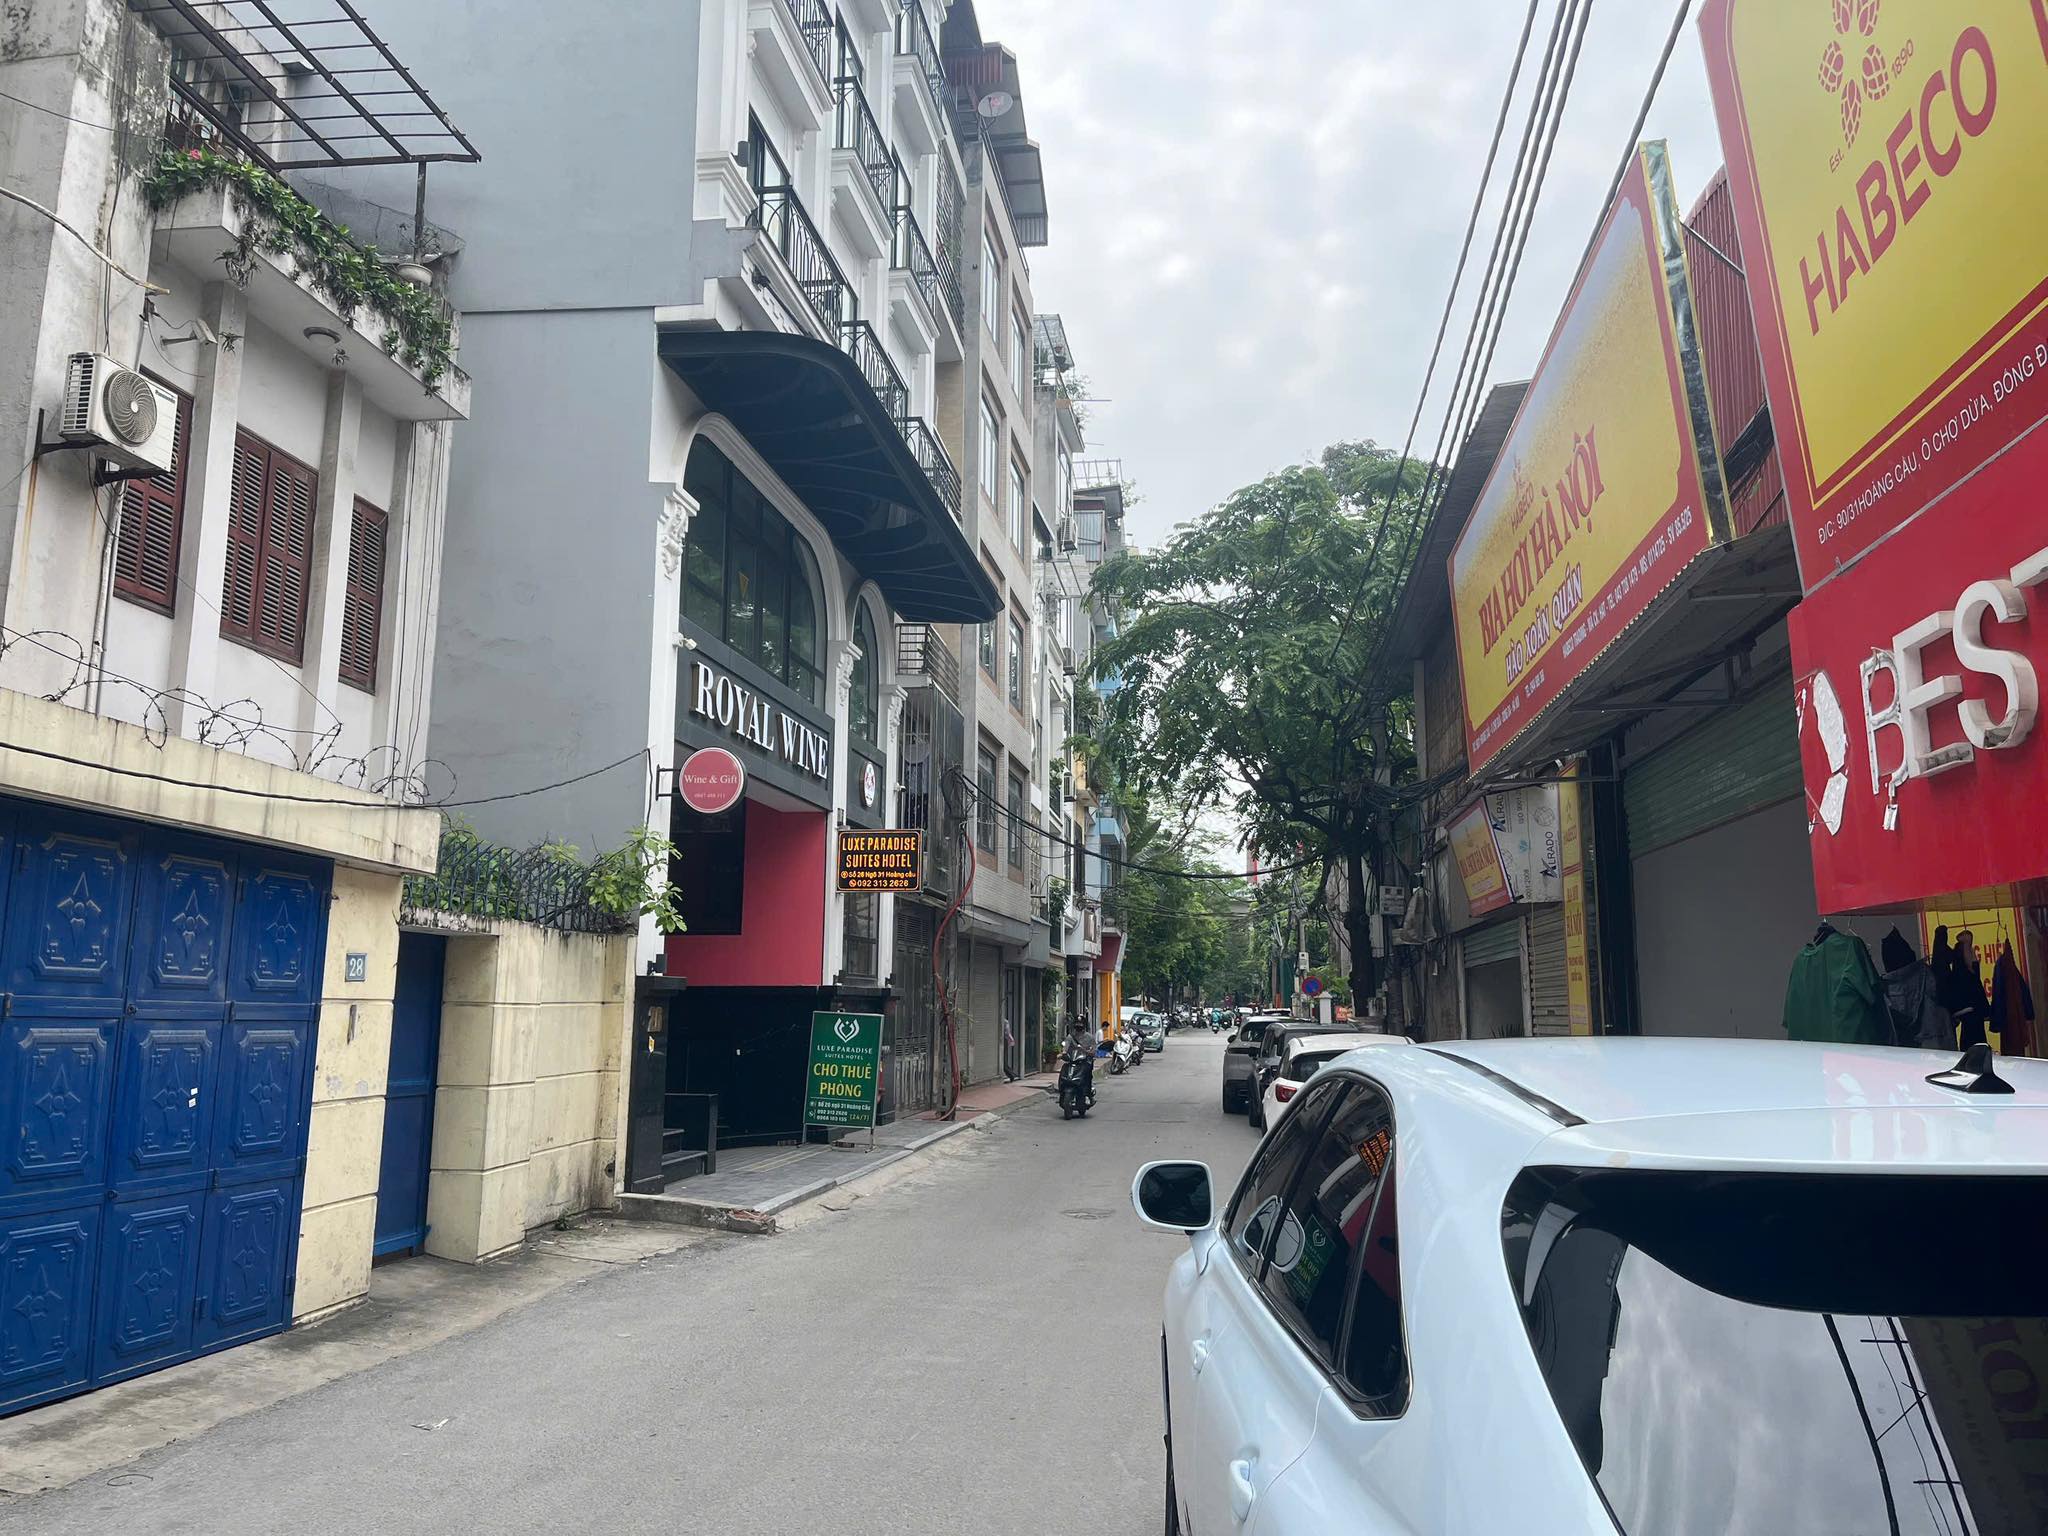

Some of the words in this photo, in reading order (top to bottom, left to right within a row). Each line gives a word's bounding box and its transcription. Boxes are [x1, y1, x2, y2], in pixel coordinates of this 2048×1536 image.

[1891, 39, 1913, 79] 1890
[1829, 148, 1845, 174] Est.
[1799, 25, 1998, 337] HABECO
[1818, 520, 1837, 544] Đ/C:
[1921, 438, 1931, 461] Ô
[1932, 416, 1959, 452] CHỢ
[1960, 393, 1993, 430] DỪA,
[1992, 355, 2034, 402] ĐỐNG
[1478, 584, 1505, 658] BIA
[1501, 537, 1534, 626] HƠI
[1529, 486, 1563, 584] HÀ
[1556, 423, 1605, 545] NỘI
[1505, 638, 1524, 687] HÀO
[1524, 603, 1550, 666] XOĂN
[1552, 561, 1583, 633] QUÁN
[1860, 545, 2048, 796] BES
[693, 661, 775, 751] ROYAL
[780, 712, 828, 779] WINE
[684, 774, 707, 784] Wine
[709, 774, 718, 784] &
[719, 774, 738, 784] Gift
[842, 837, 866, 851] LUXE
[867, 836, 916, 851] PARADISE
[846, 854, 880, 868] SUITES
[882, 853, 912, 868] HOTEL
[857, 880, 872, 888] 092
[873, 880, 888, 888] 313
[350, 957, 364, 977] 28
[817, 1044, 835, 1052] LUXE
[836, 1045, 873, 1055] PARADISE
[813, 1062, 838, 1077] CHO
[841, 1062, 872, 1079] THUÊ
[820, 1080, 862, 1098] PHÒNG
